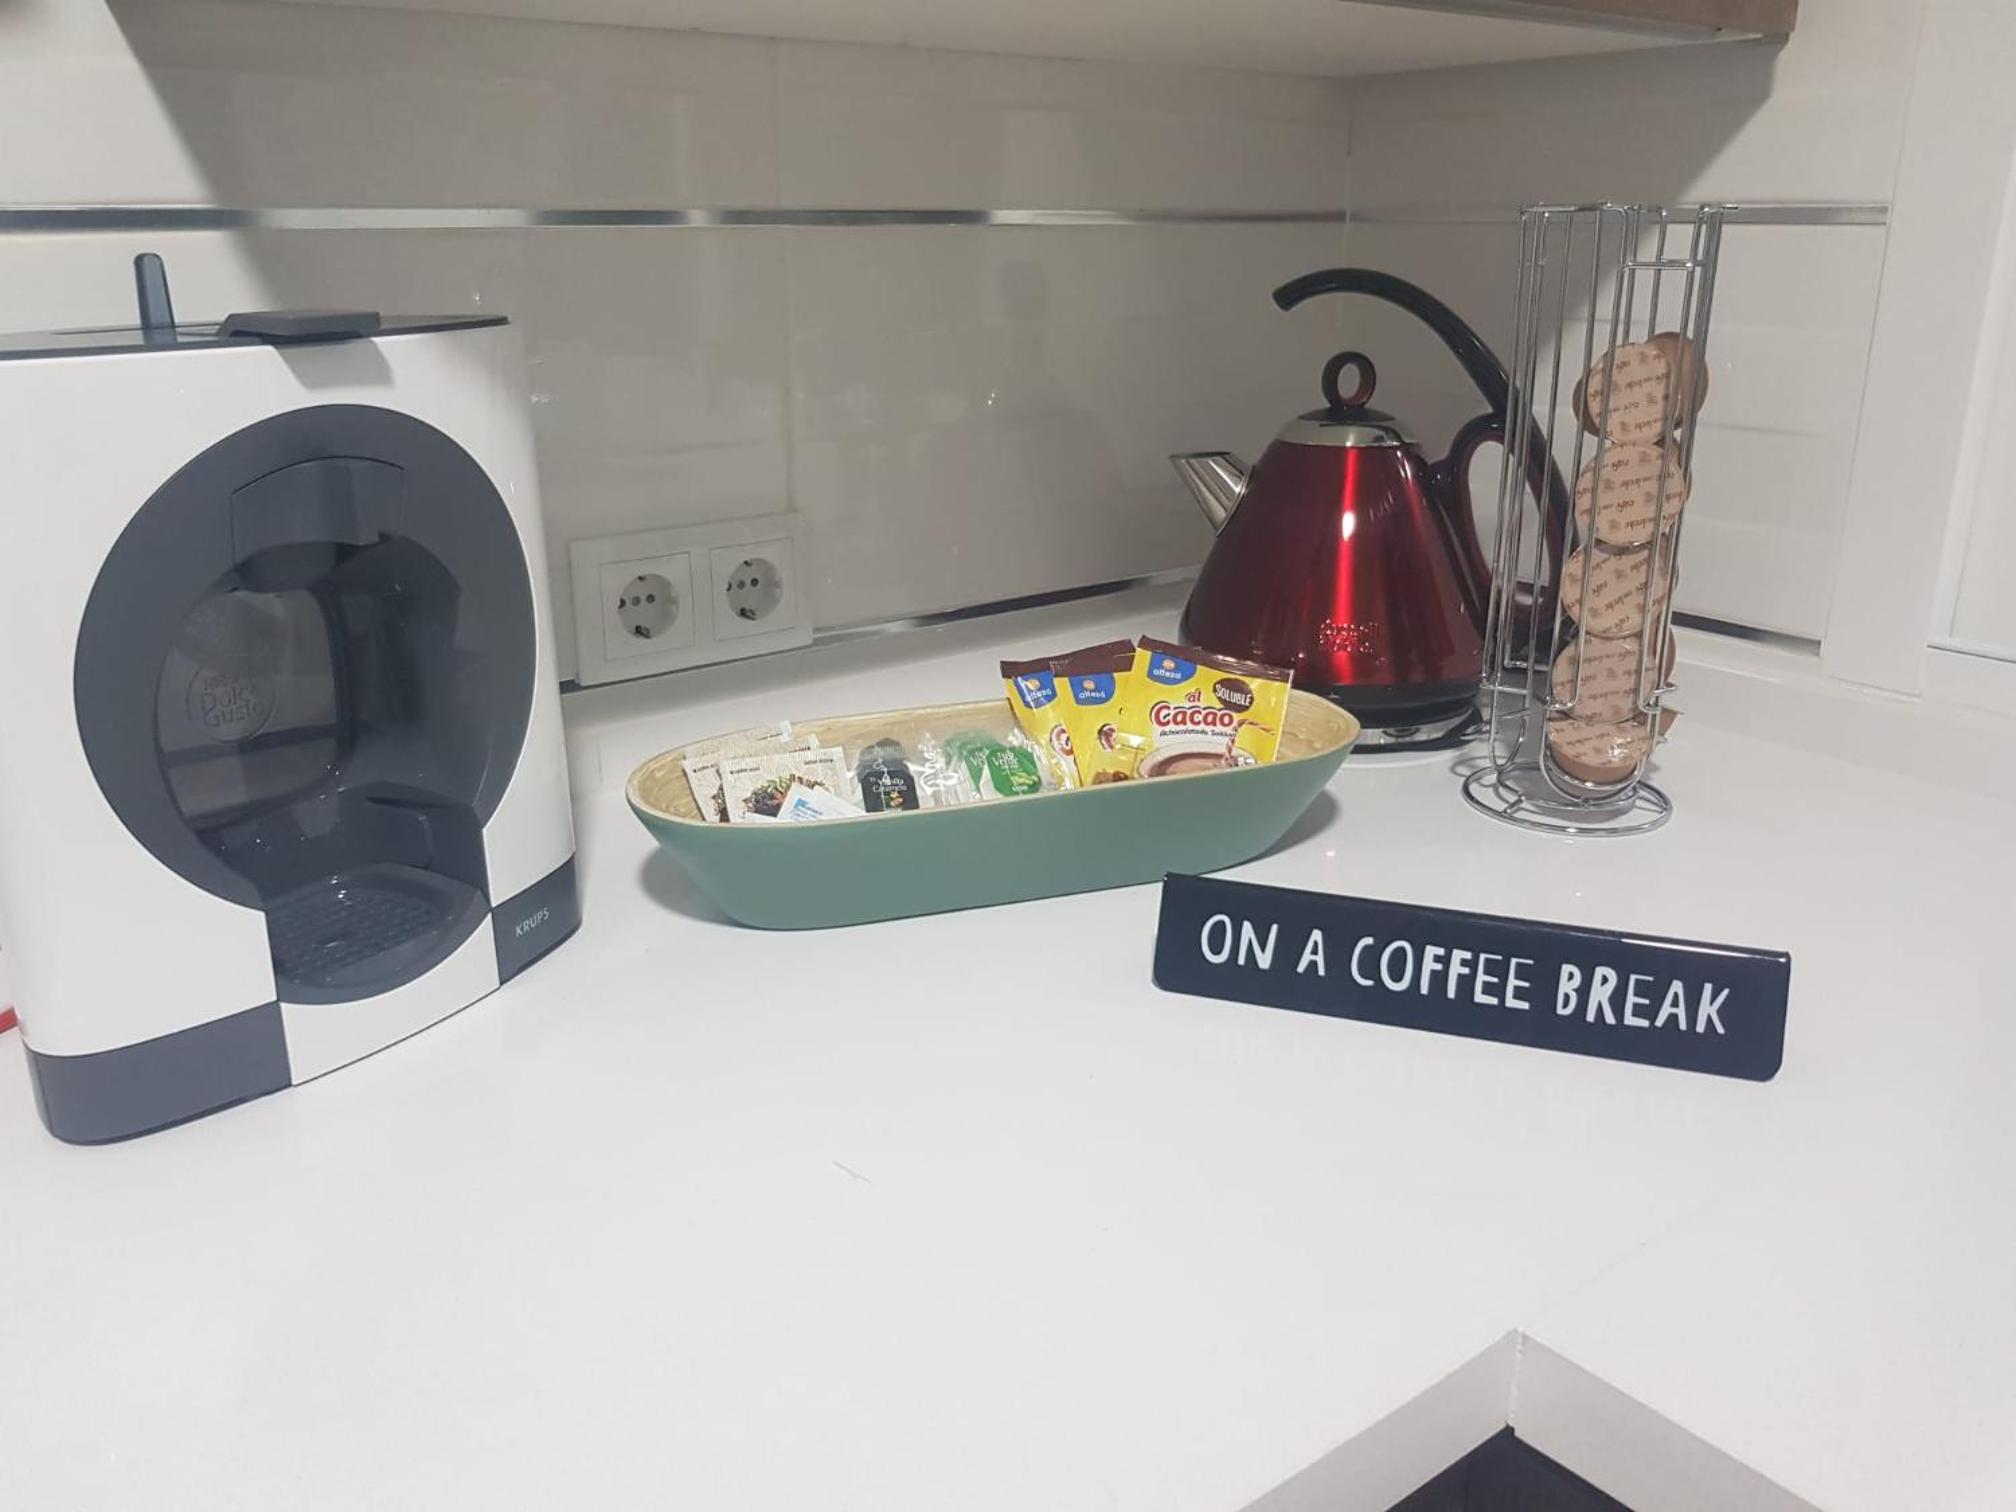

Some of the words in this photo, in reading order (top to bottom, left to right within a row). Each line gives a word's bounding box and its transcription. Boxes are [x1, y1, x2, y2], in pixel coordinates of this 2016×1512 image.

[1186, 688, 1202, 704] al
[1215, 683, 1253, 706] SOLUBLE
[1152, 702, 1235, 728] Cacao
[515, 906, 550, 937] KRUPS
[1200, 914, 1279, 970] ON
[1296, 929, 1326, 976] A
[1350, 936, 1534, 1011] COFFEE
[1556, 963, 1731, 1035] BREAK
